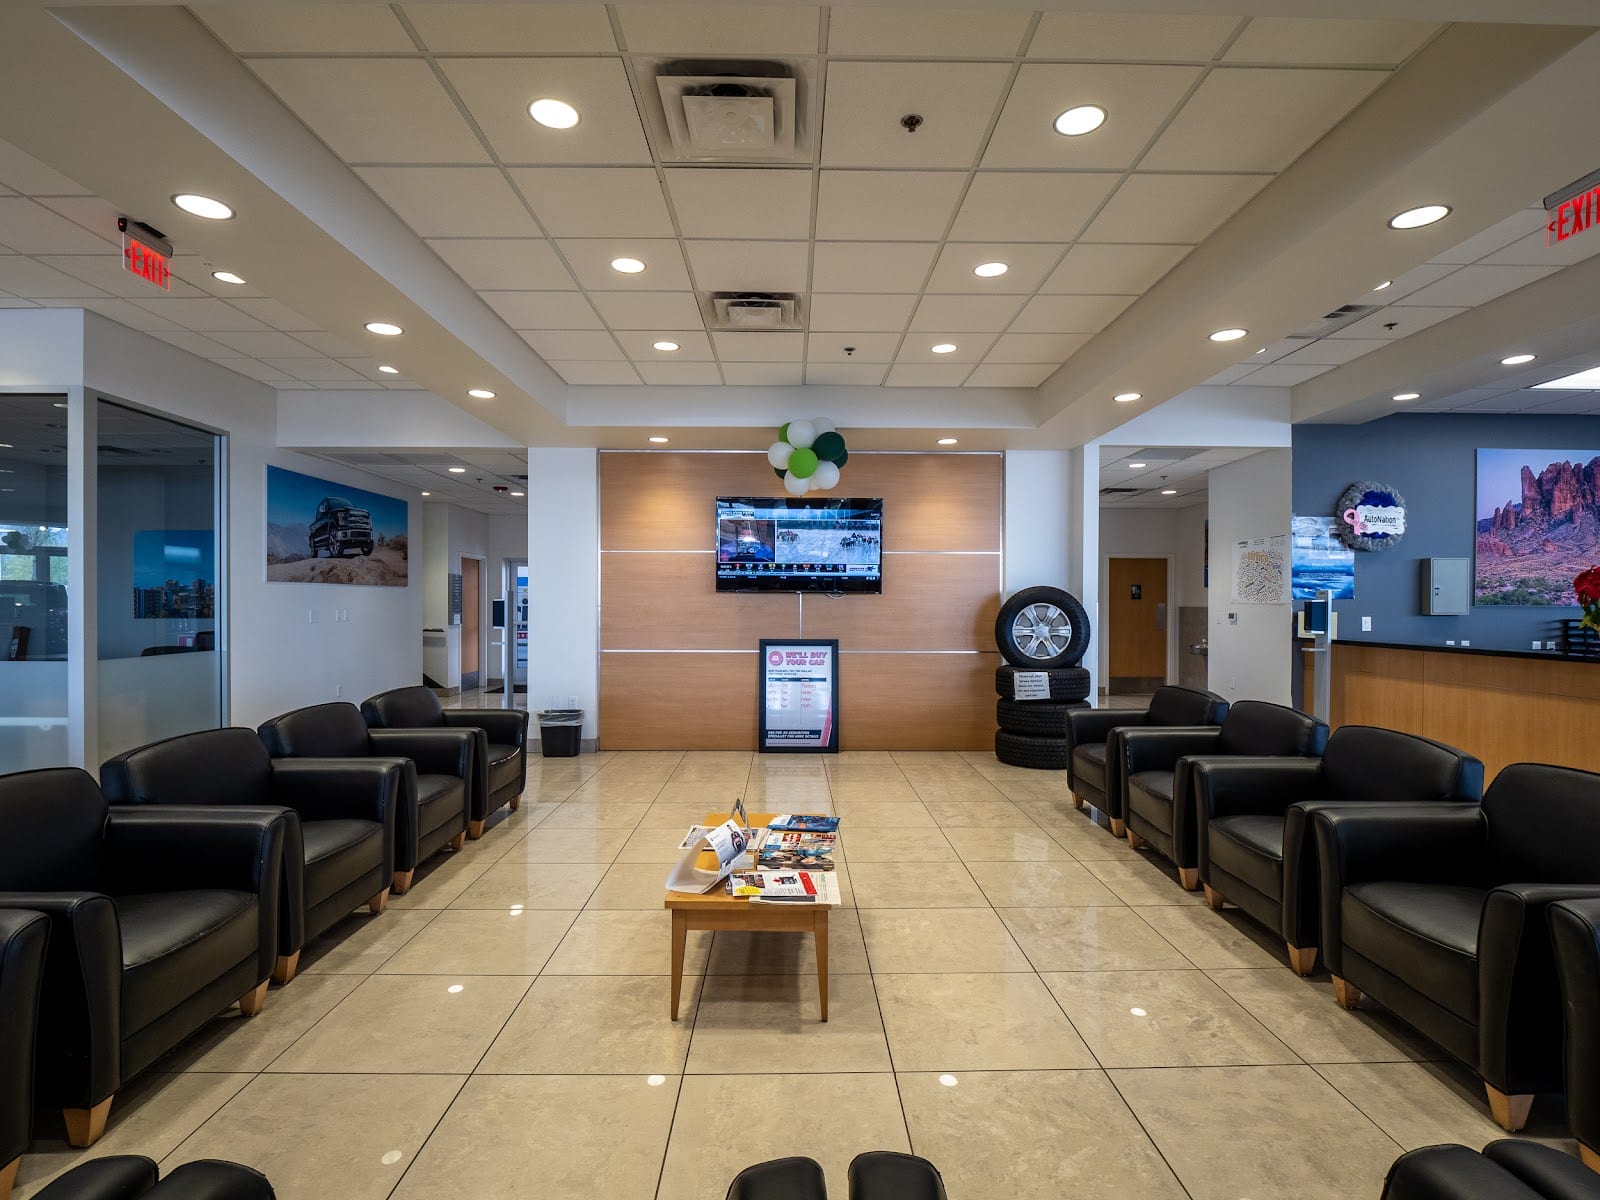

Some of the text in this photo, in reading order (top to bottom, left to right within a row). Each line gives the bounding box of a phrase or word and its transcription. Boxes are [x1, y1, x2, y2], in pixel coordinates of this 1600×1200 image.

[131, 239, 165, 288] EXIT
[1363, 514, 1397, 525] AutoNation
[785, 651, 827, 659] WE'LL BUY
